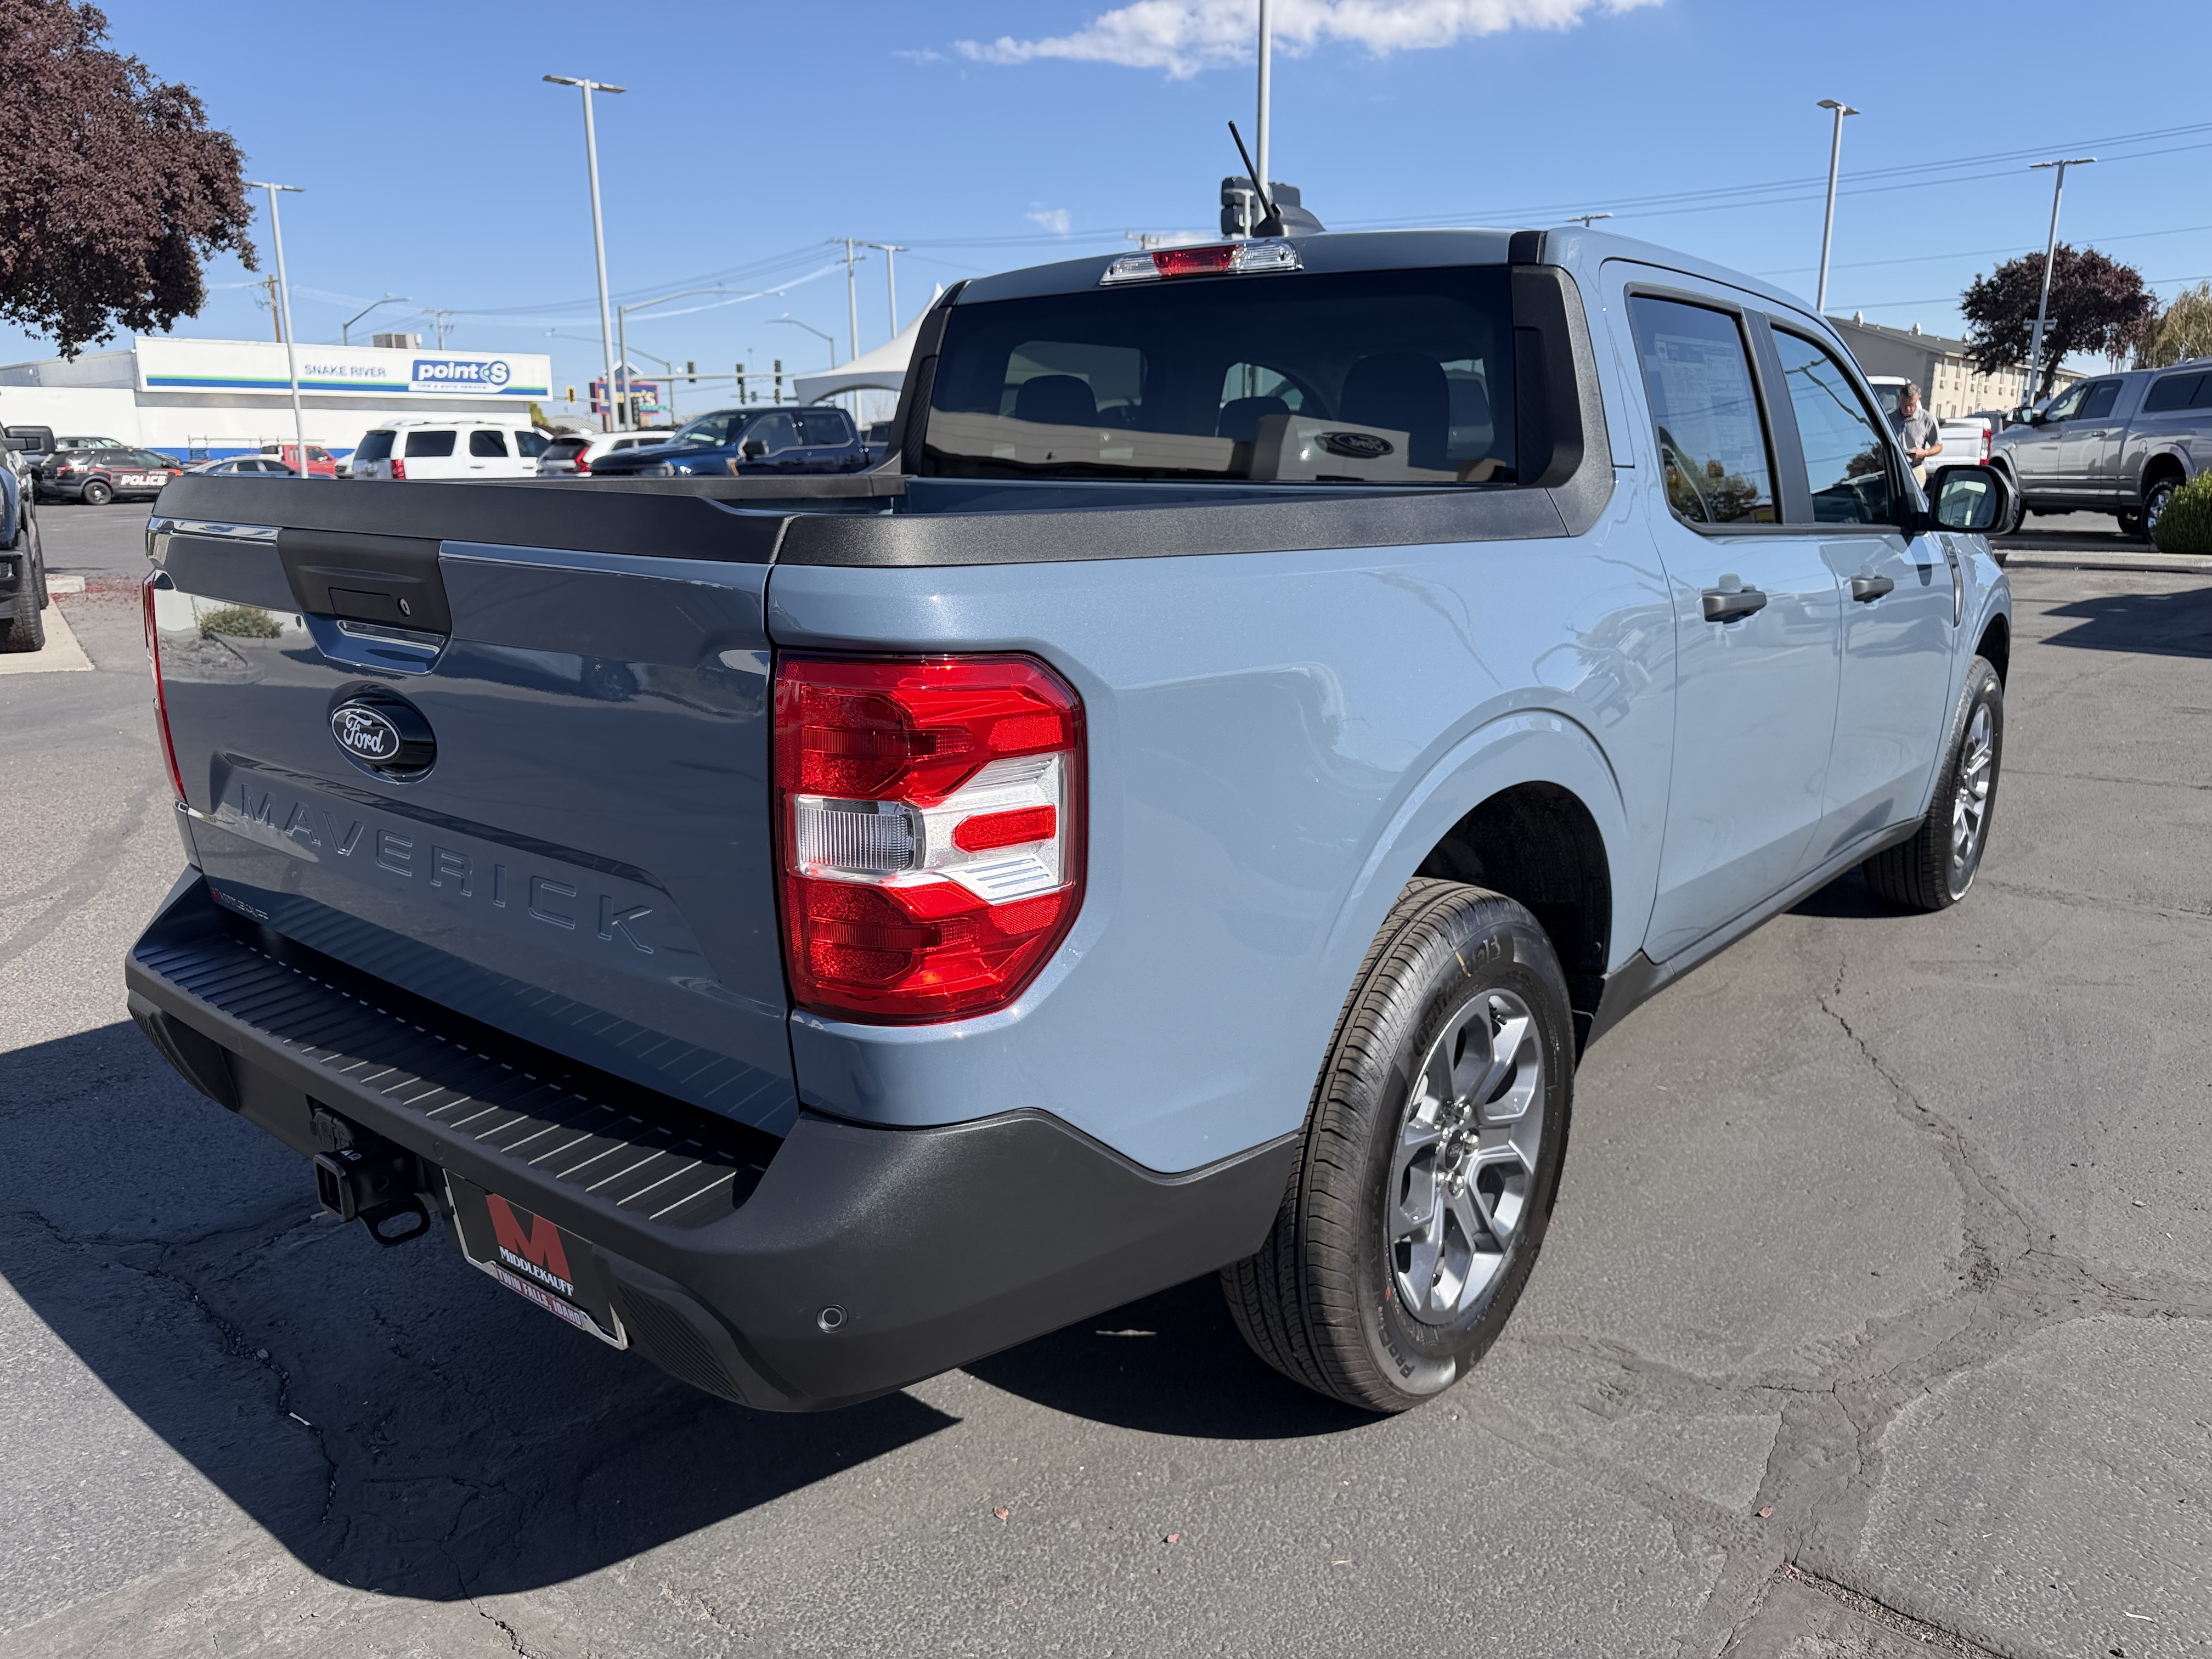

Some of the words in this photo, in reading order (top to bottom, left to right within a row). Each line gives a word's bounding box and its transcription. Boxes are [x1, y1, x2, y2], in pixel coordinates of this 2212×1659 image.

[304, 364, 347, 376] SNAKE
[350, 365, 386, 377] RIVER
[418, 362, 479, 381] point
[488, 363, 507, 383] S
[120, 475, 167, 486] POLICE
[343, 714, 384, 753] Ford
[241, 783, 654, 954] MAVERICK
[498, 1245, 574, 1297] MIDDLEKAUFF
[496, 1268, 522, 1292] TWIN
[522, 1284, 552, 1311] FALLS,
[552, 1299, 582, 1325] IDAHO
